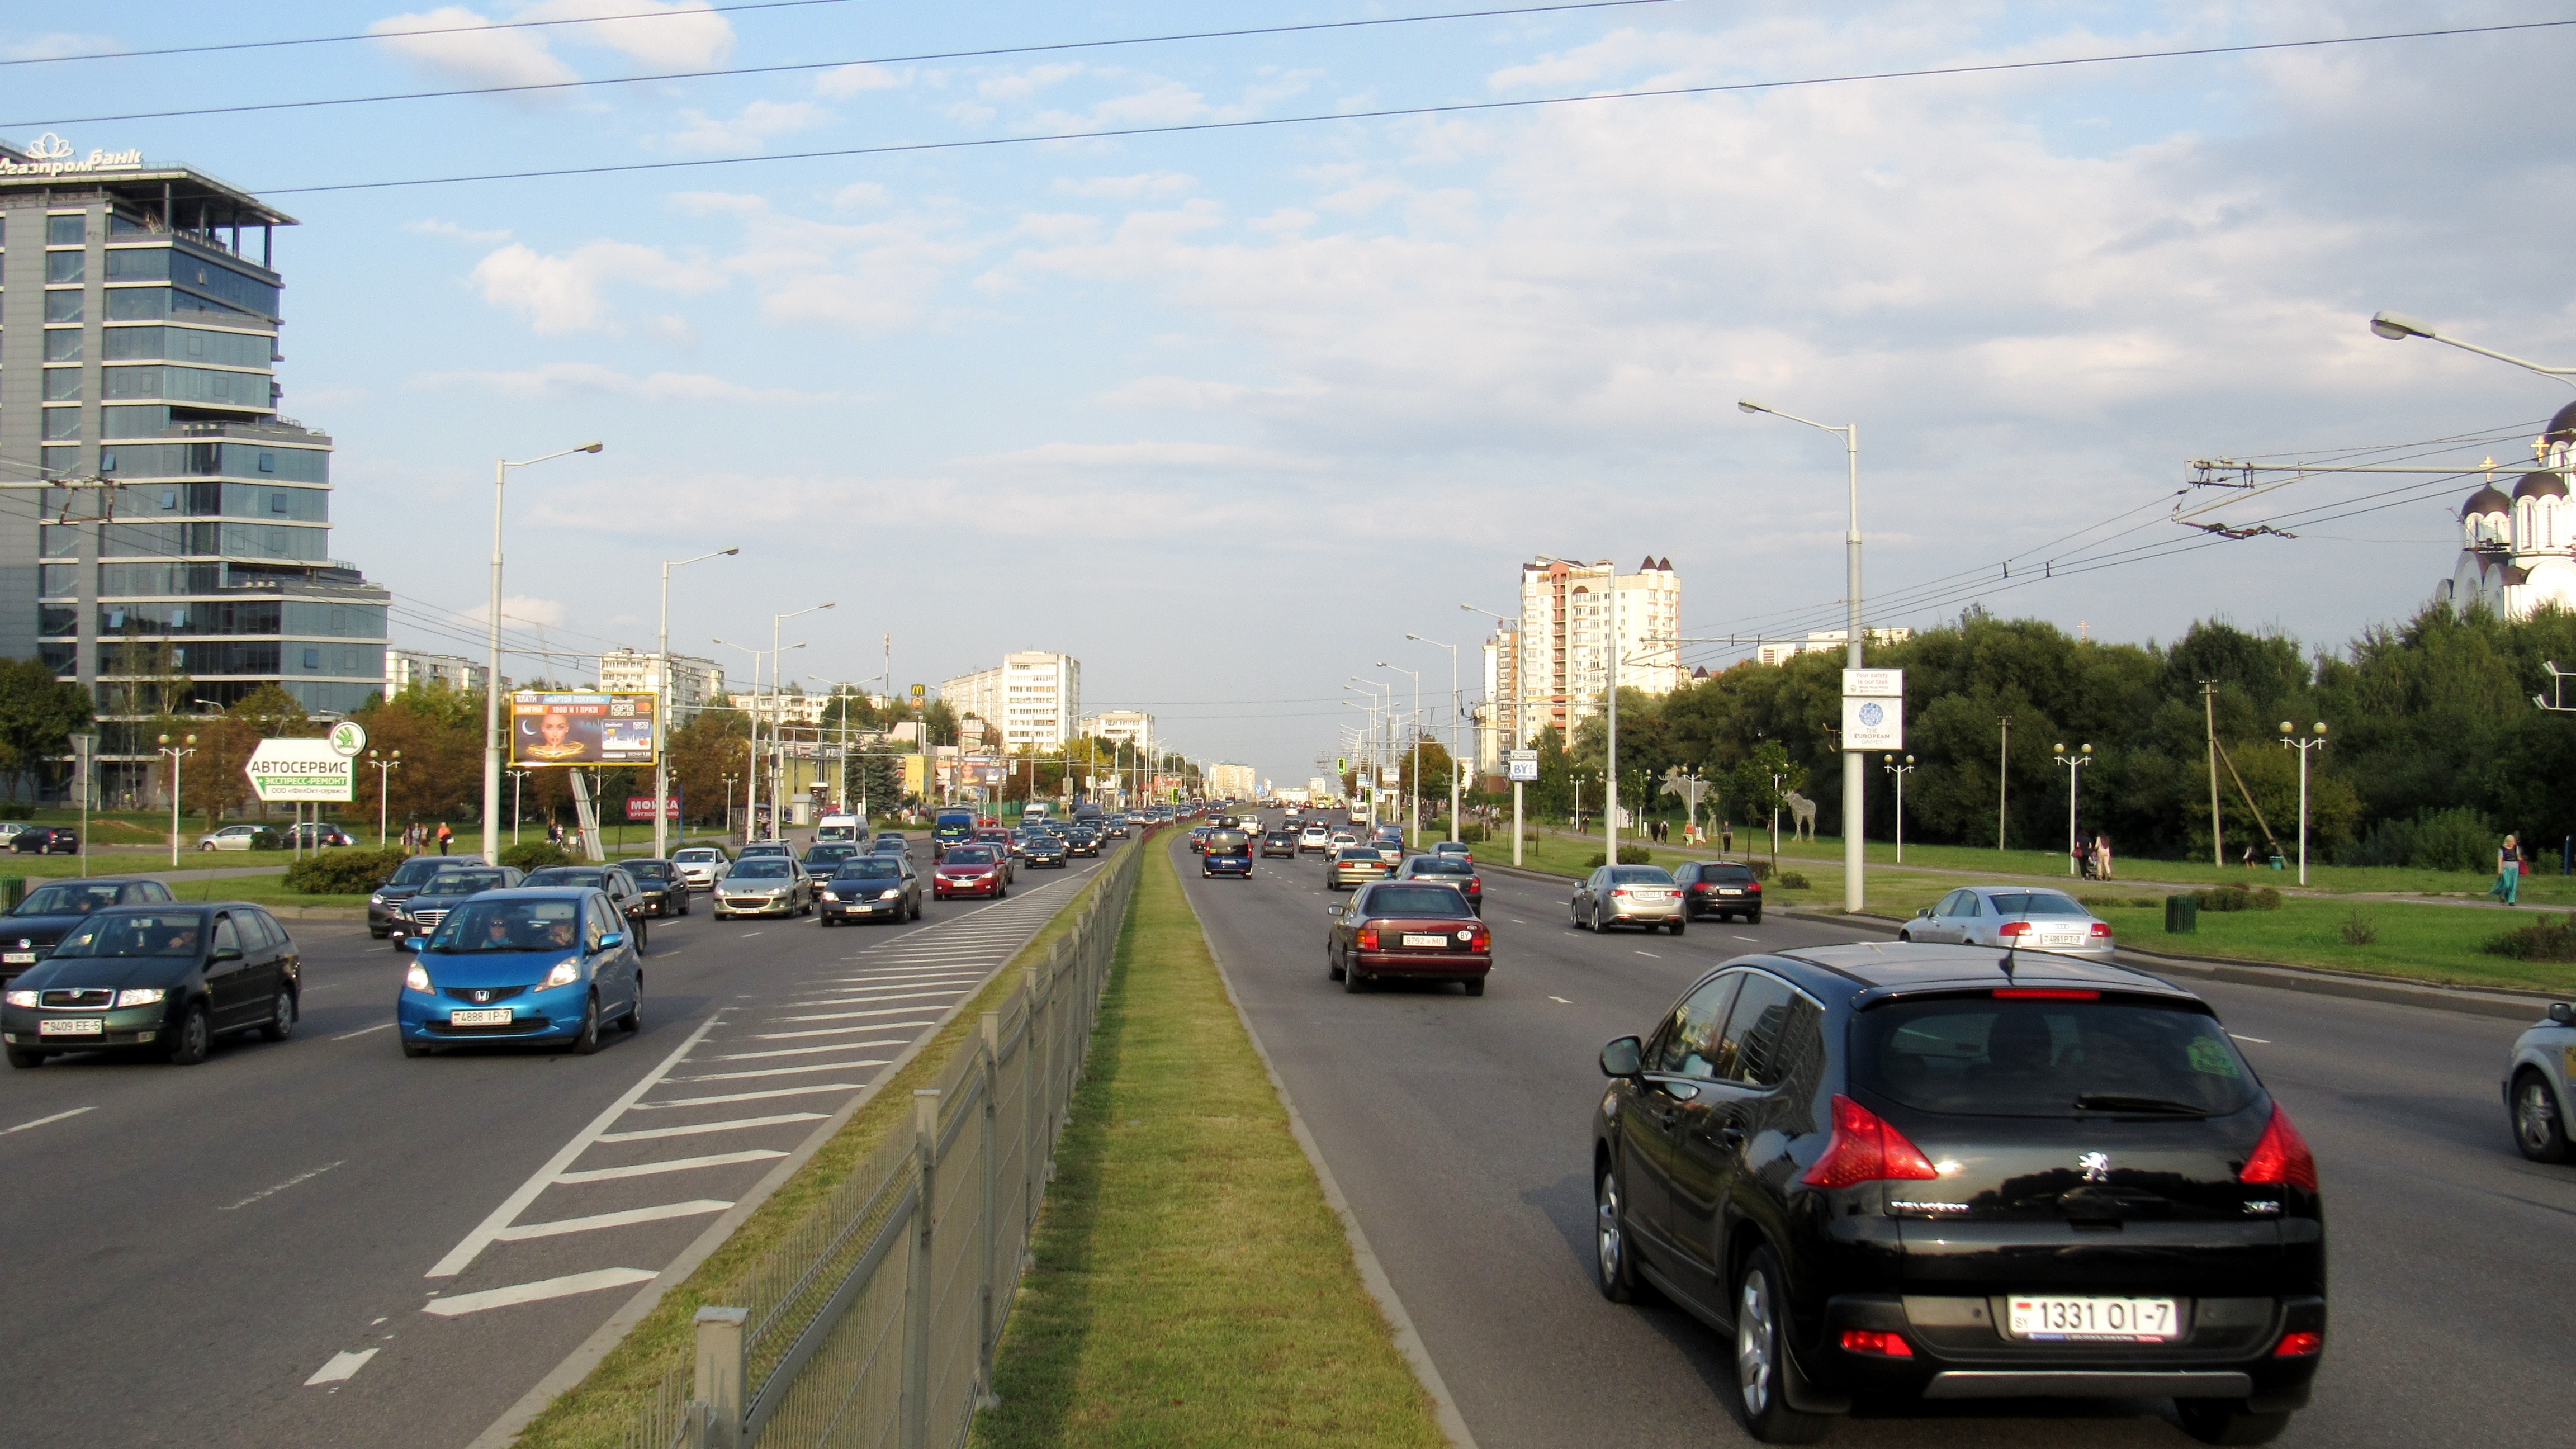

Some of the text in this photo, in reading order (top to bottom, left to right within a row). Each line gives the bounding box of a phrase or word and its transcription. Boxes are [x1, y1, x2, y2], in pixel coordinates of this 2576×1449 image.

[252, 761, 347, 773] АВТОСЕРВИС
[461, 1011, 510, 1021] 4888 IP-7
[51, 1021, 100, 1031] 9409 EE-5
[2040, 1301, 2169, 1331] 1331 OI-7
